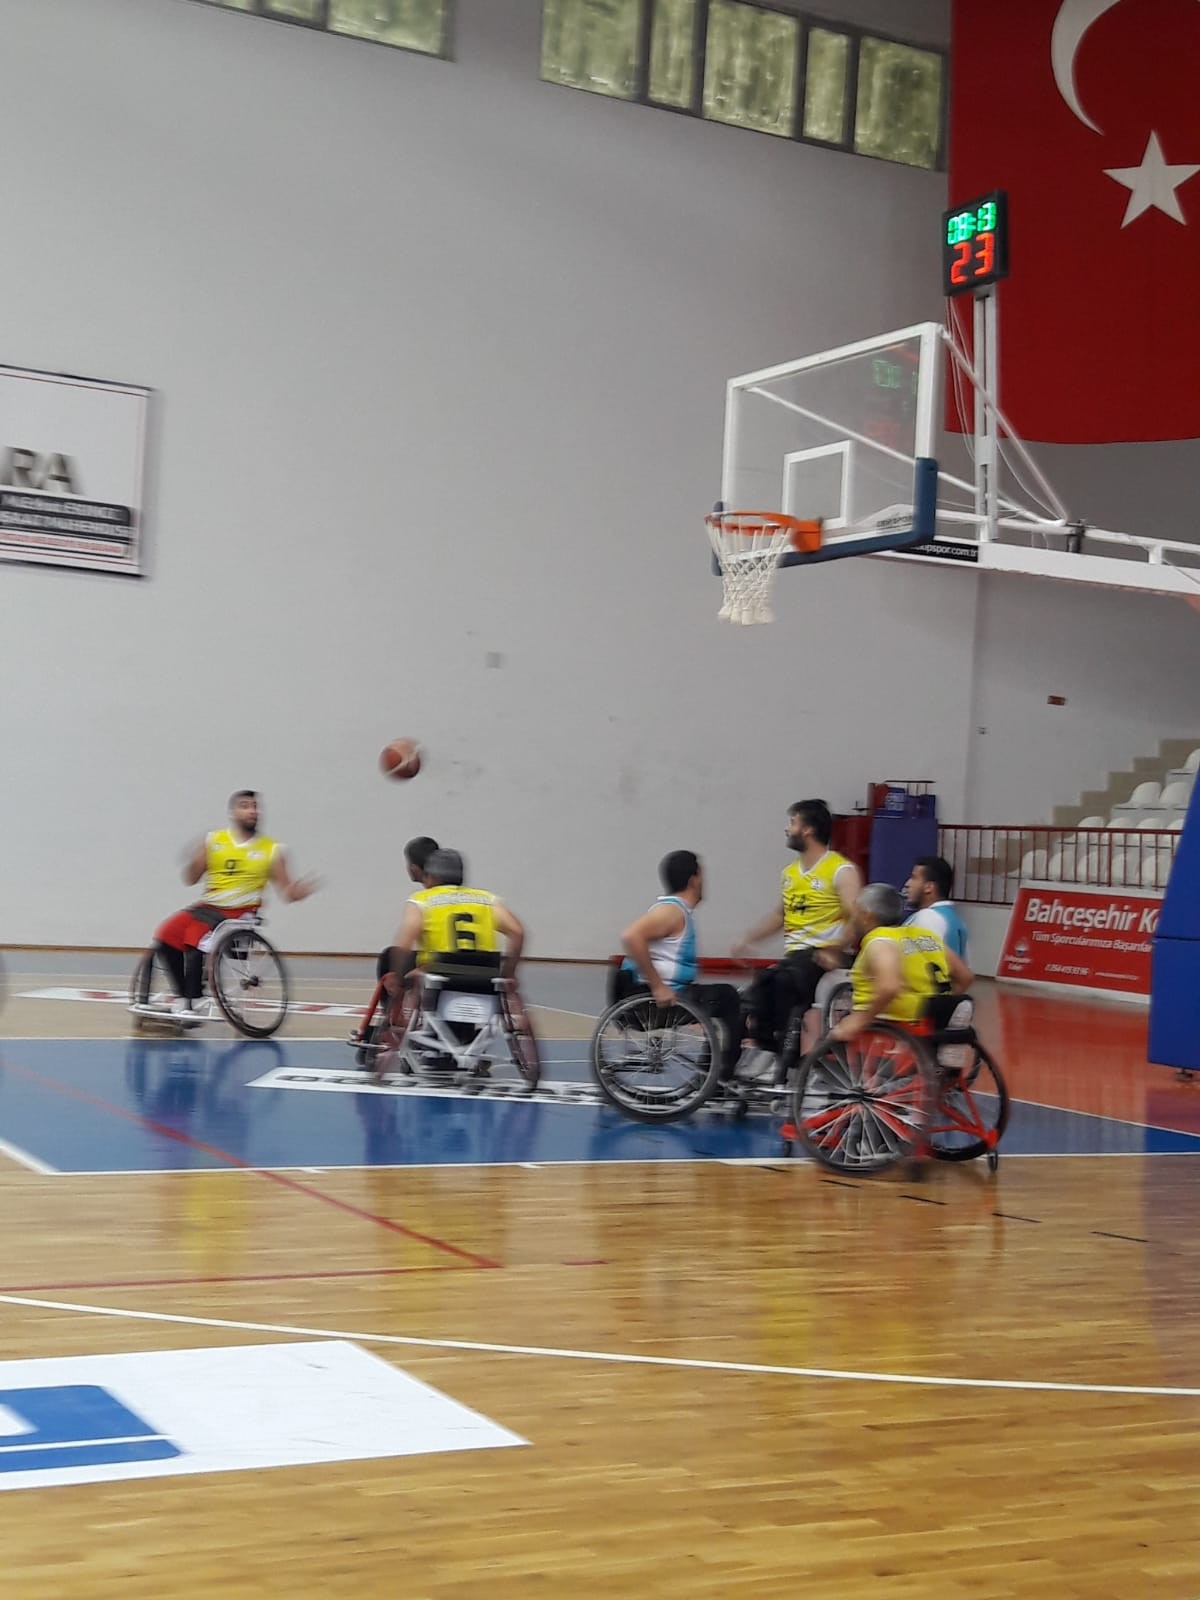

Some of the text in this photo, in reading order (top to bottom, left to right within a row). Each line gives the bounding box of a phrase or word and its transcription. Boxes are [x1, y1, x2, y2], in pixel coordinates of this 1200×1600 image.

[950, 232, 995, 284] 23
[447, 912, 476, 952] 6
[1024, 898, 1138, 932] Bahçeşehir
